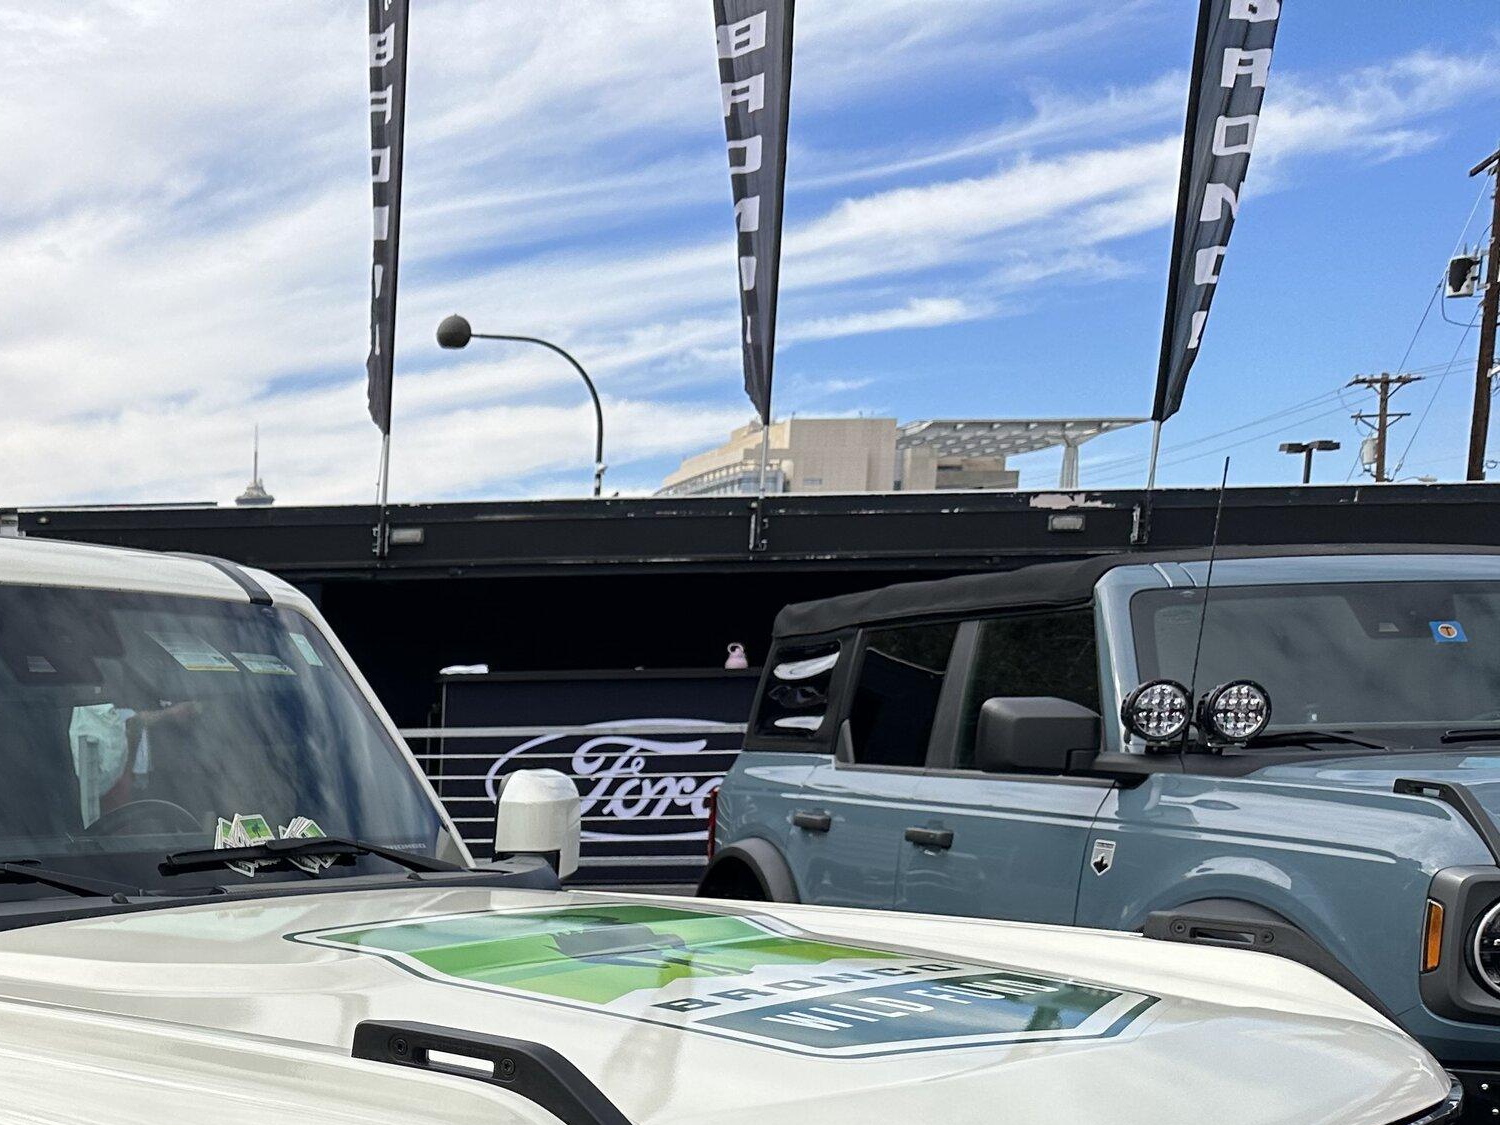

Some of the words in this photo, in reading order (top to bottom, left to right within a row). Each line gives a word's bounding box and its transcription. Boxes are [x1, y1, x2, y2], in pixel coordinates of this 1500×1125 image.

[1187, 0, 1281, 349] BRONC
[650, 963, 961, 1013] BRONCO
[762, 996, 935, 1031] WILD
[906, 976, 1060, 1004] FUND
